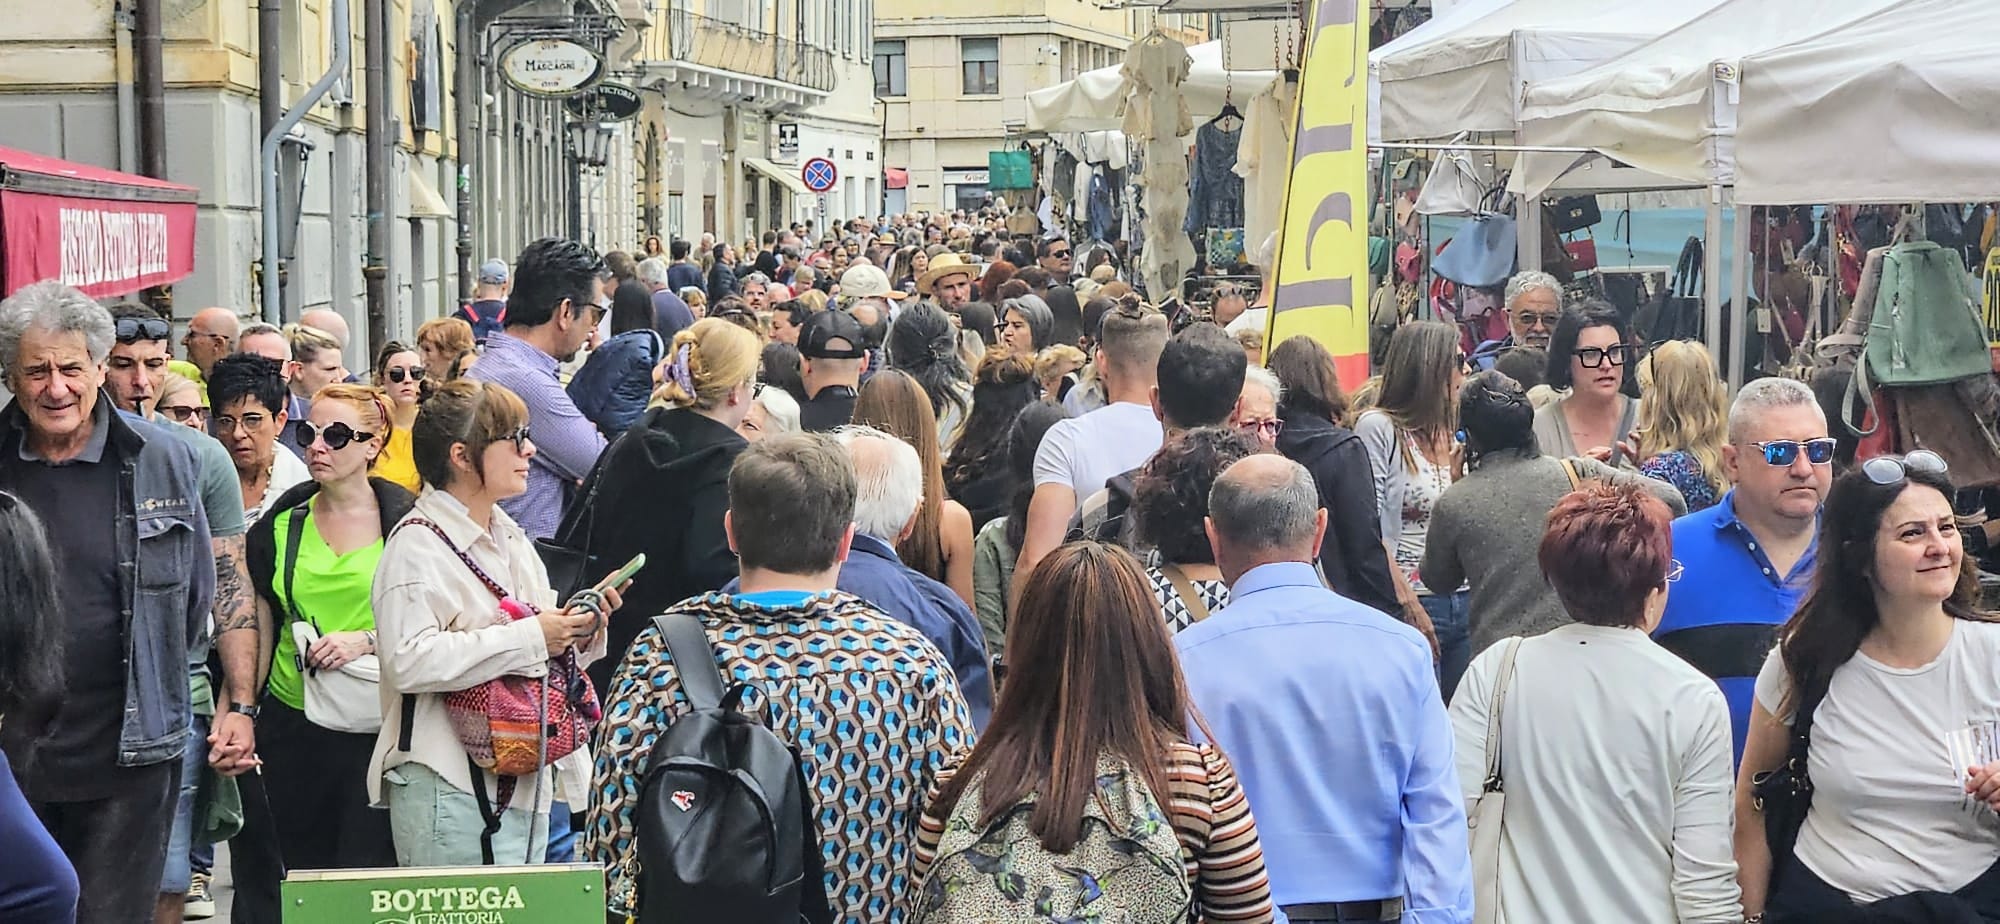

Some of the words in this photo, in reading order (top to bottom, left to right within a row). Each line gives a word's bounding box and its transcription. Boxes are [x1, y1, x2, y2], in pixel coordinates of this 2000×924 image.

[600, 87, 635, 102] VICTORIA
[60, 208, 103, 286] RISTORO
[371, 886, 525, 912] BOTTEGA
[429, 911, 504, 924] FATTORIA
